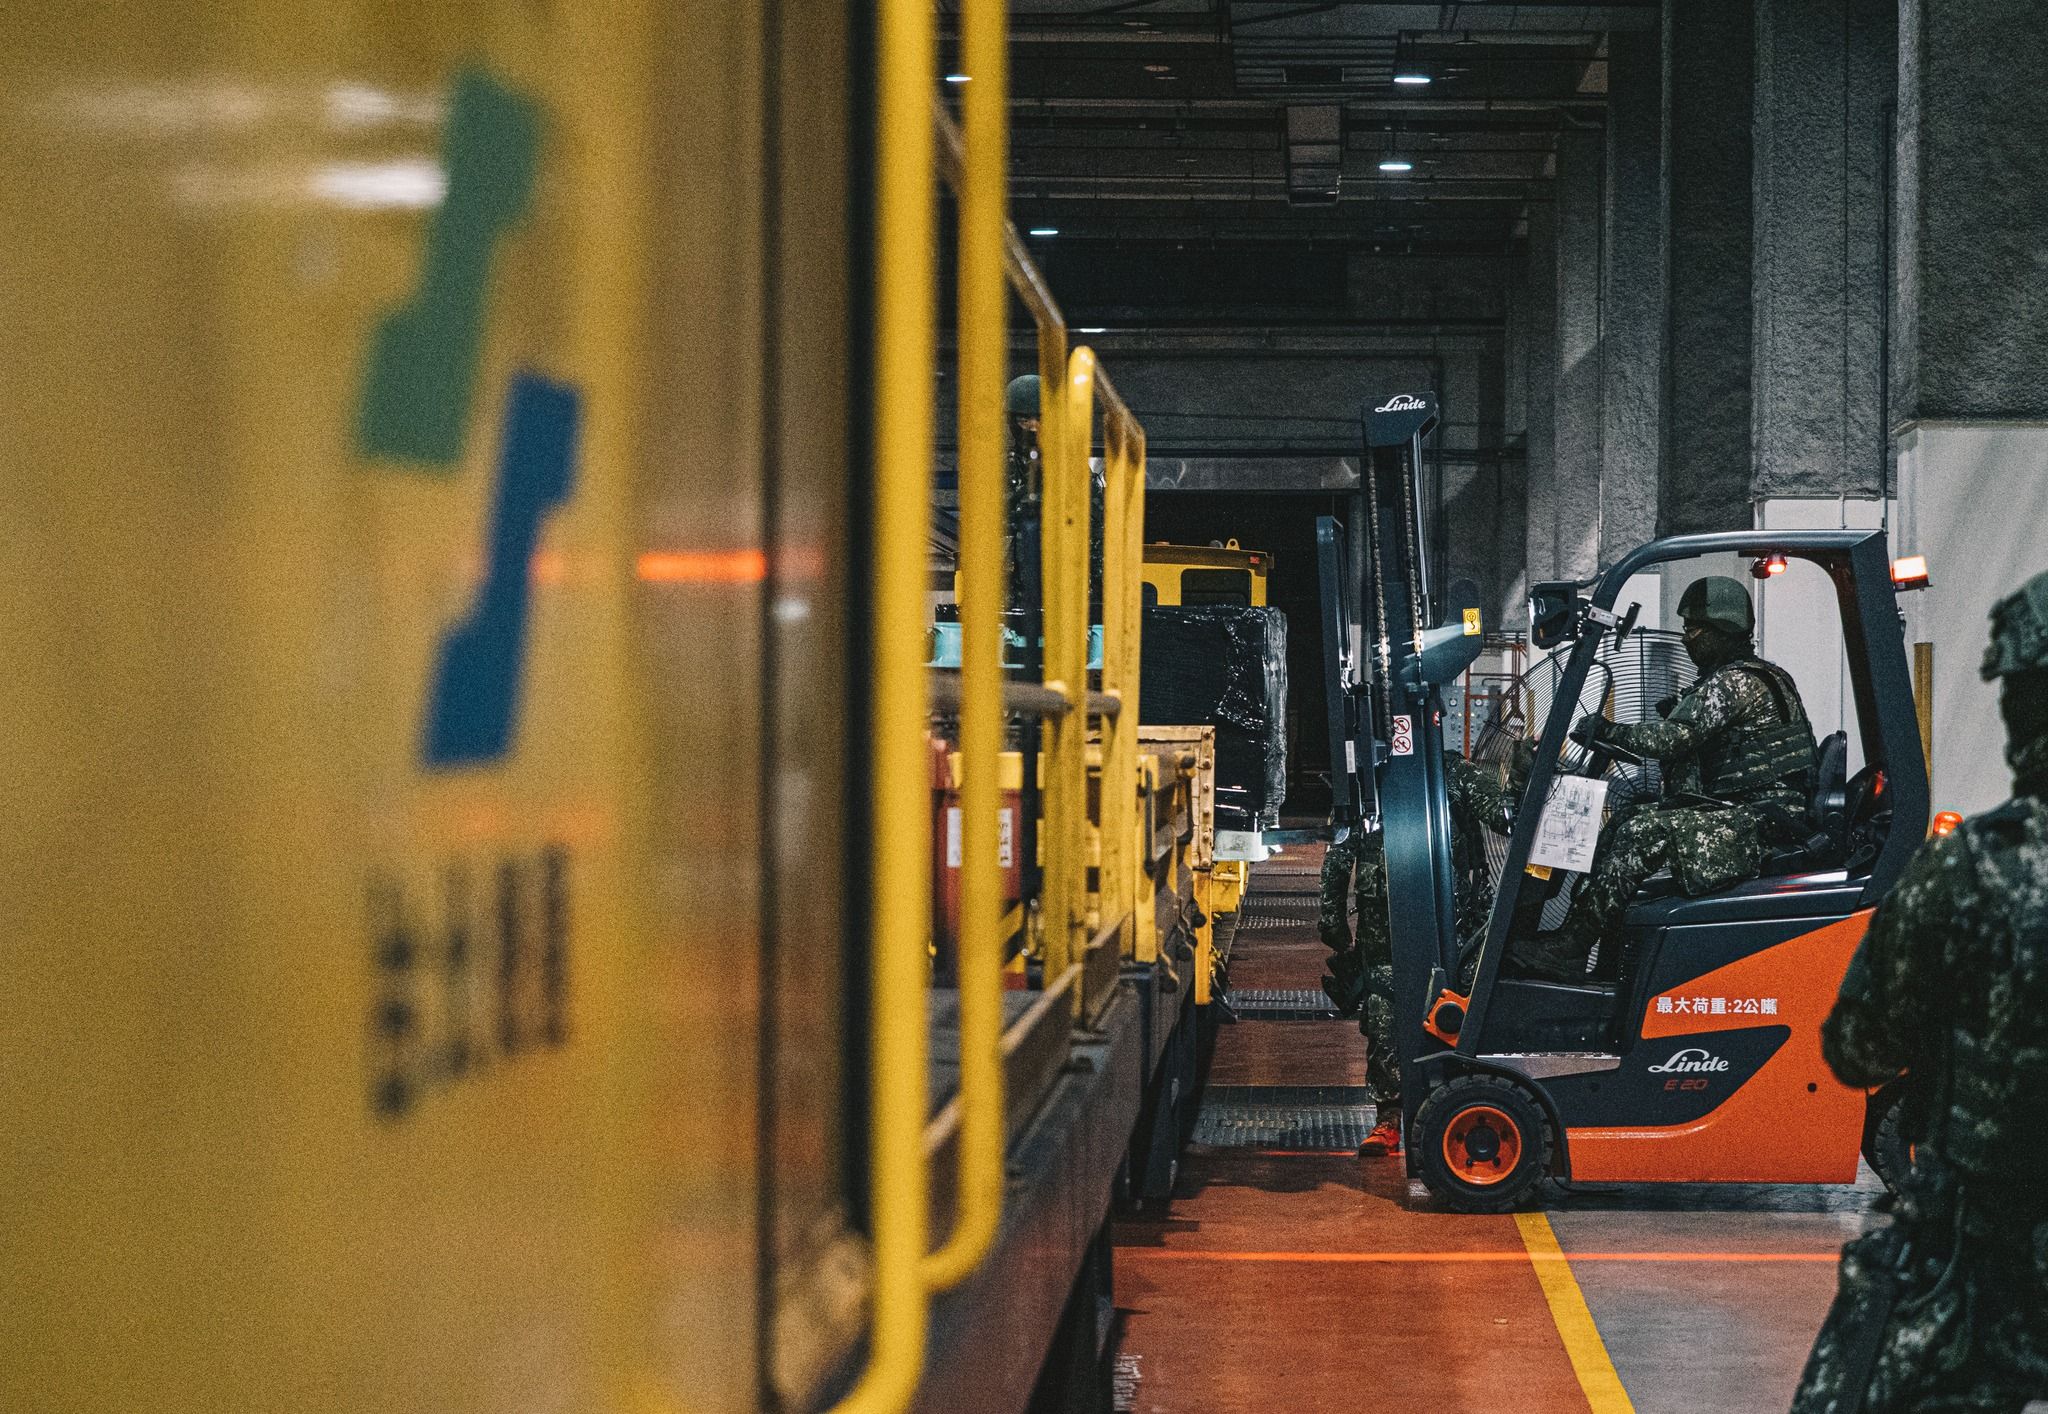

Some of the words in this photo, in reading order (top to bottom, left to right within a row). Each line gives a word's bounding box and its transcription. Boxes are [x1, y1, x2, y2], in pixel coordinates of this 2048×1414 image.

[1374, 394, 1427, 413] Linde
[1647, 1048, 1729, 1073] Linde
[1664, 1079, 1679, 1090] E
[1680, 1079, 1709, 1090] 20
